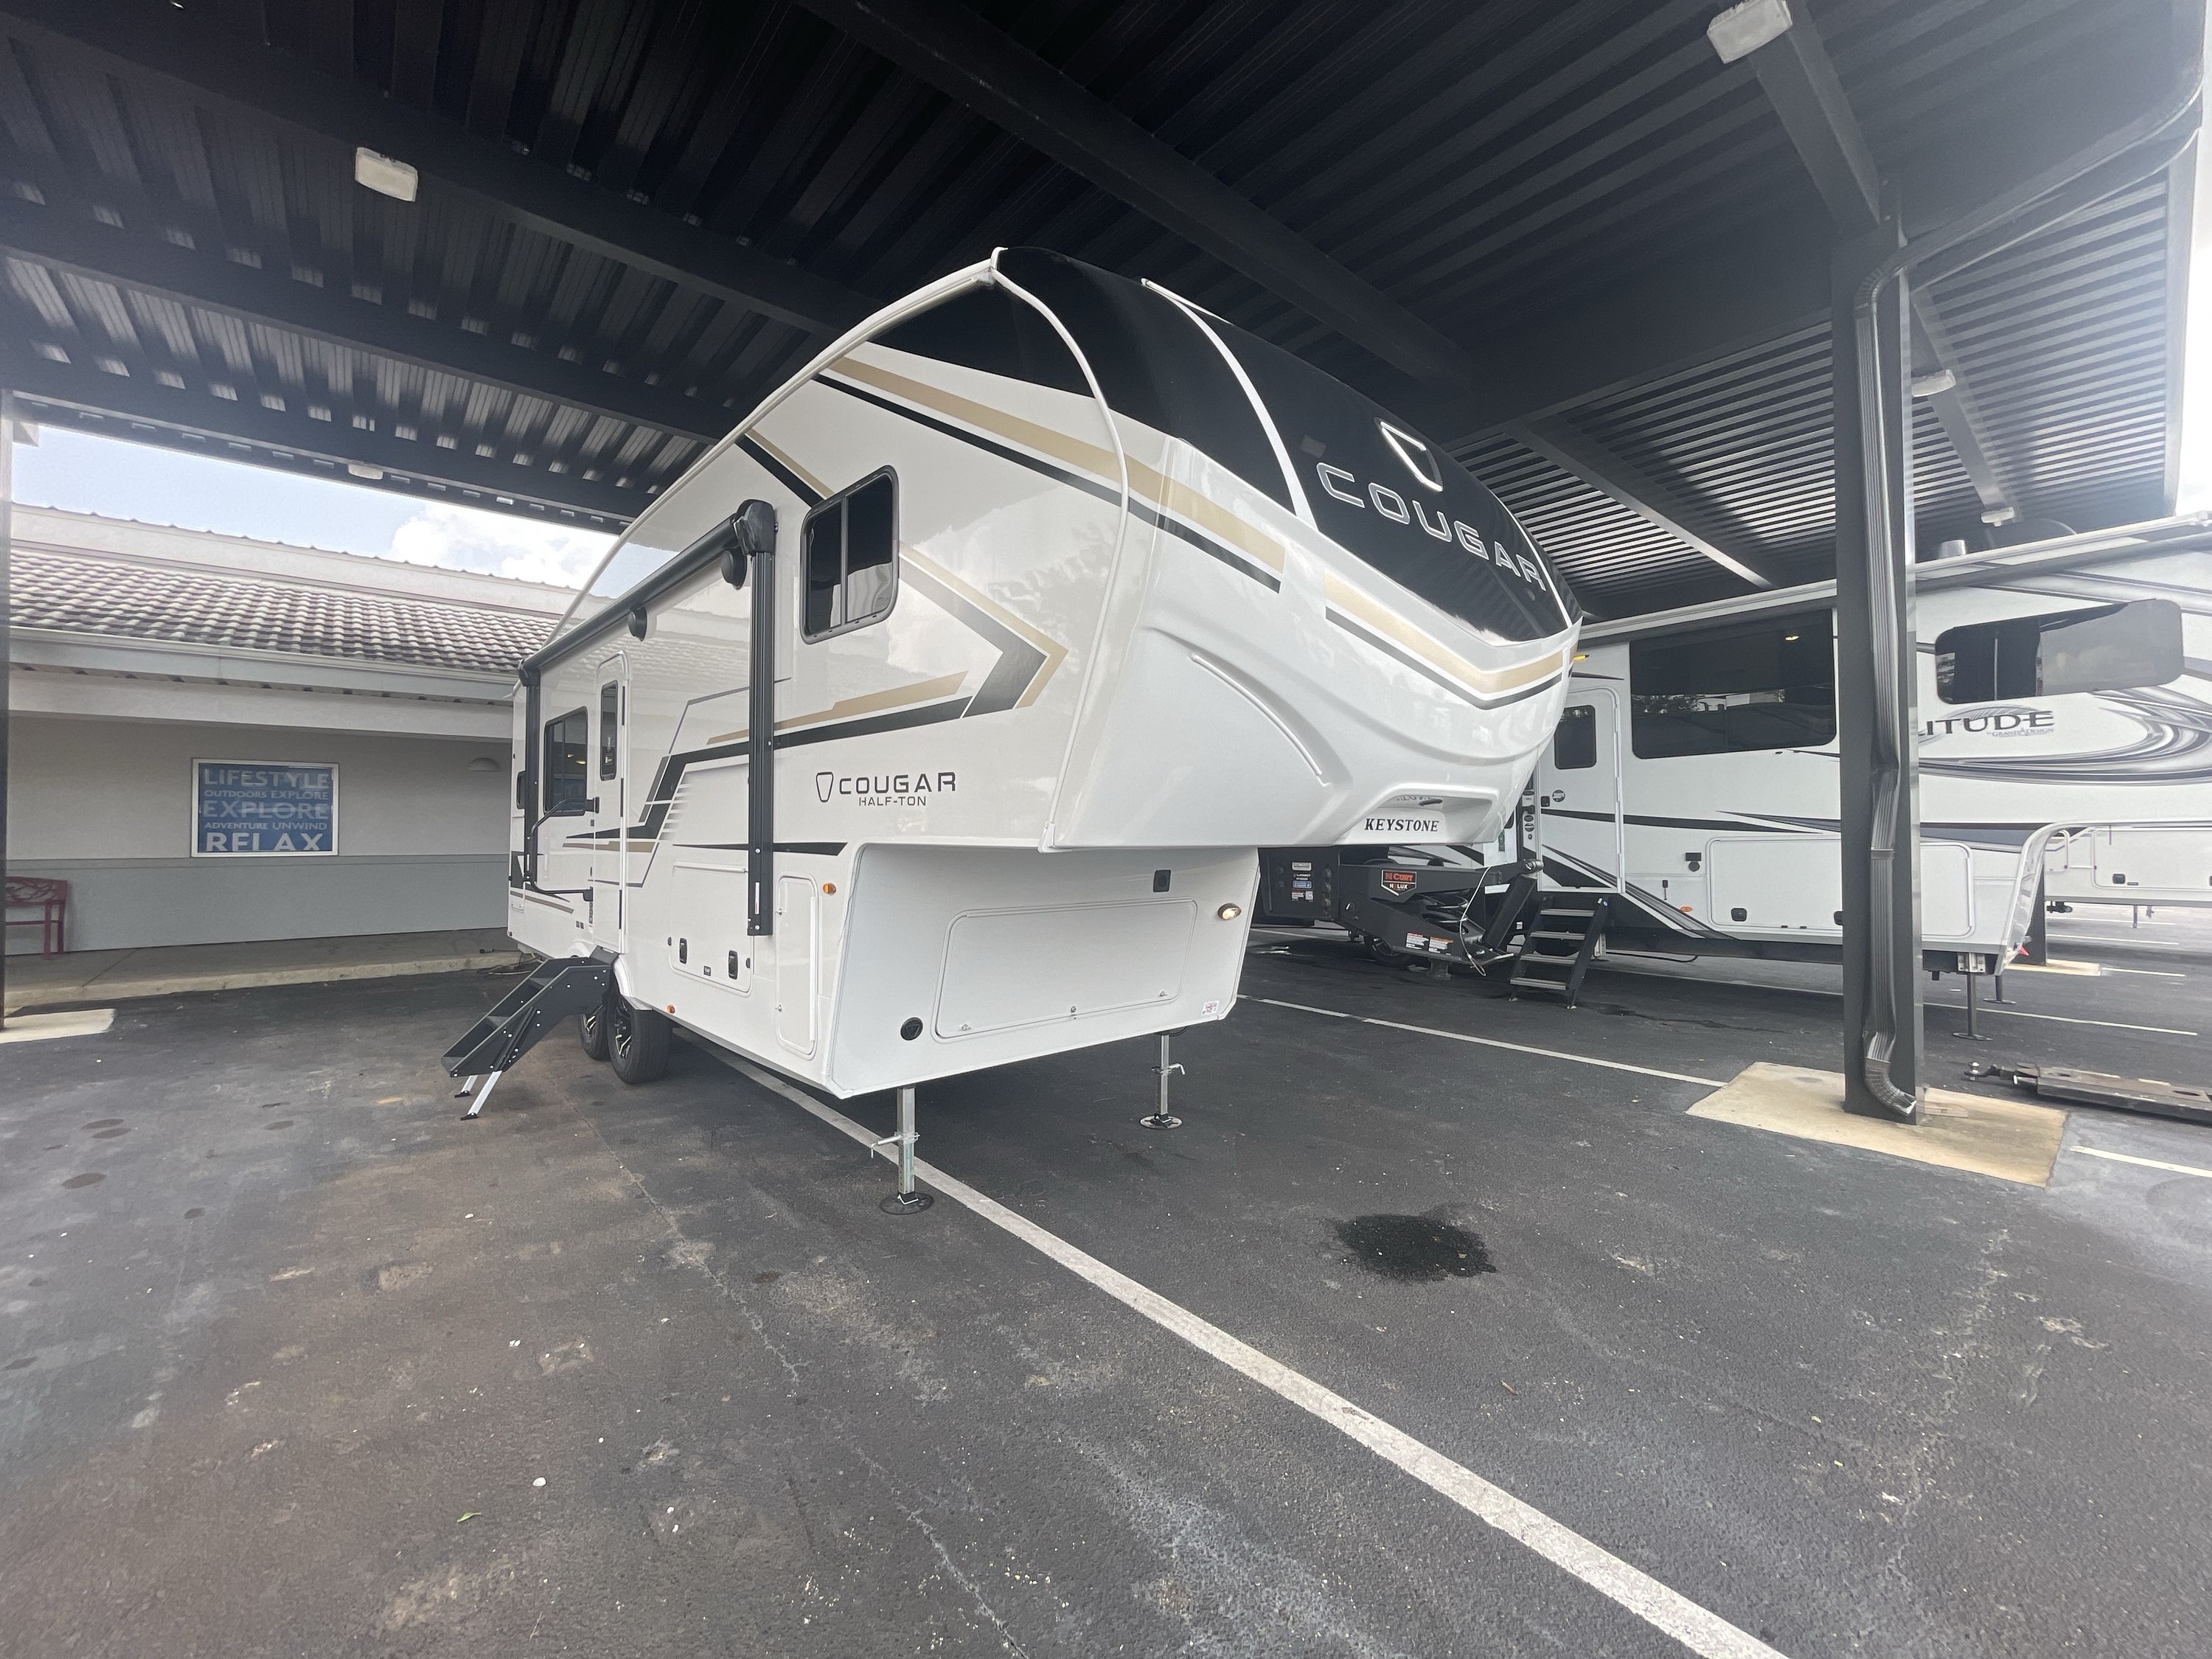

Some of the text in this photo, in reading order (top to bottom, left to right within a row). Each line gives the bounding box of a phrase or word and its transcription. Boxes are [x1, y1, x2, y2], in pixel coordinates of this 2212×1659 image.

[1316, 462, 1547, 592] COUGAR
[1919, 710, 2055, 737] ITUDE
[204, 768, 329, 789] LIFESTYLE
[839, 771, 956, 795] COUGAR
[204, 790, 329, 800] OUTDOORS EXPLORE
[858, 796, 927, 807] HALF-TON
[203, 800, 330, 820] EXPLORE
[204, 821, 327, 831] ADVENTURE UNWIND
[1364, 818, 1439, 832] KEYSTONE
